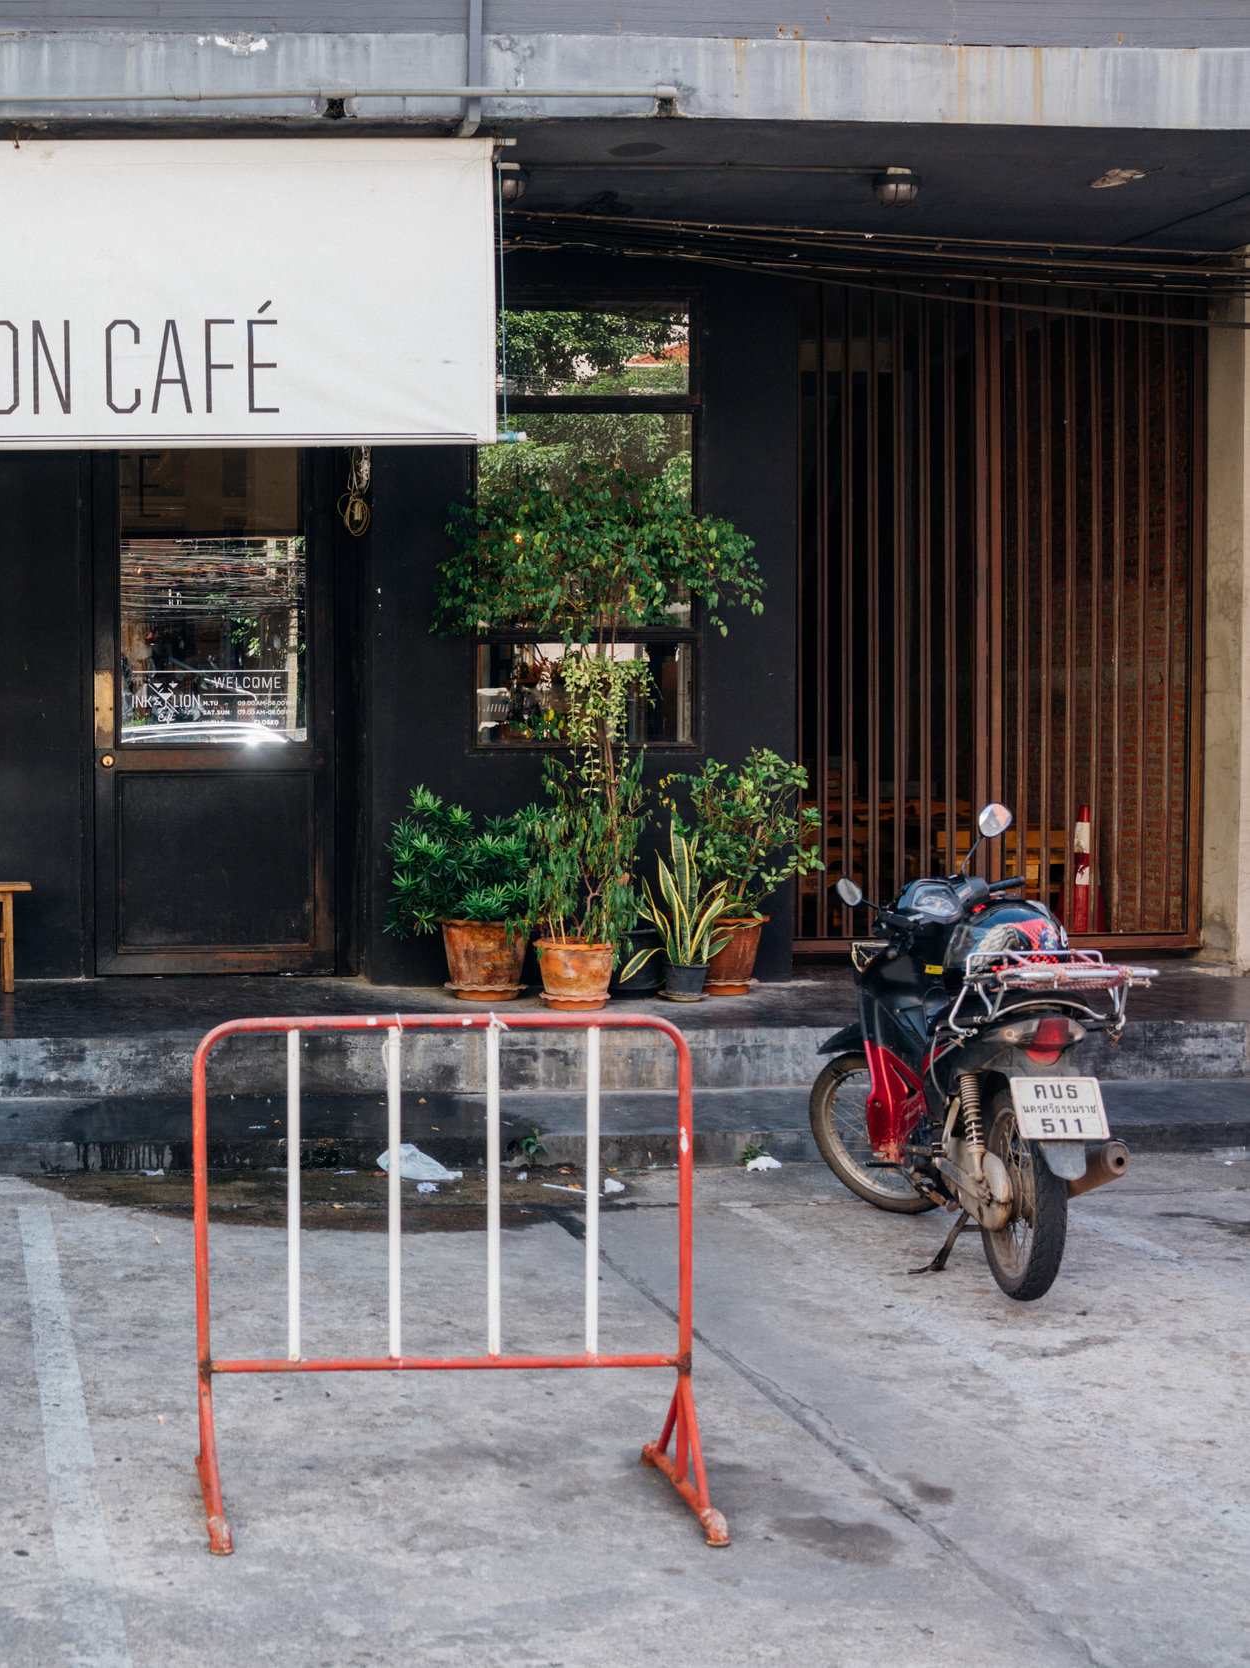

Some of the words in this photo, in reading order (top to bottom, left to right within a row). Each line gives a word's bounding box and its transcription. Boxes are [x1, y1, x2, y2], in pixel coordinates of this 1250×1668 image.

[105, 300, 279, 413] CAFÉ
[214, 676, 281, 689] WELCOME
[1041, 1118, 1083, 1133] 511
